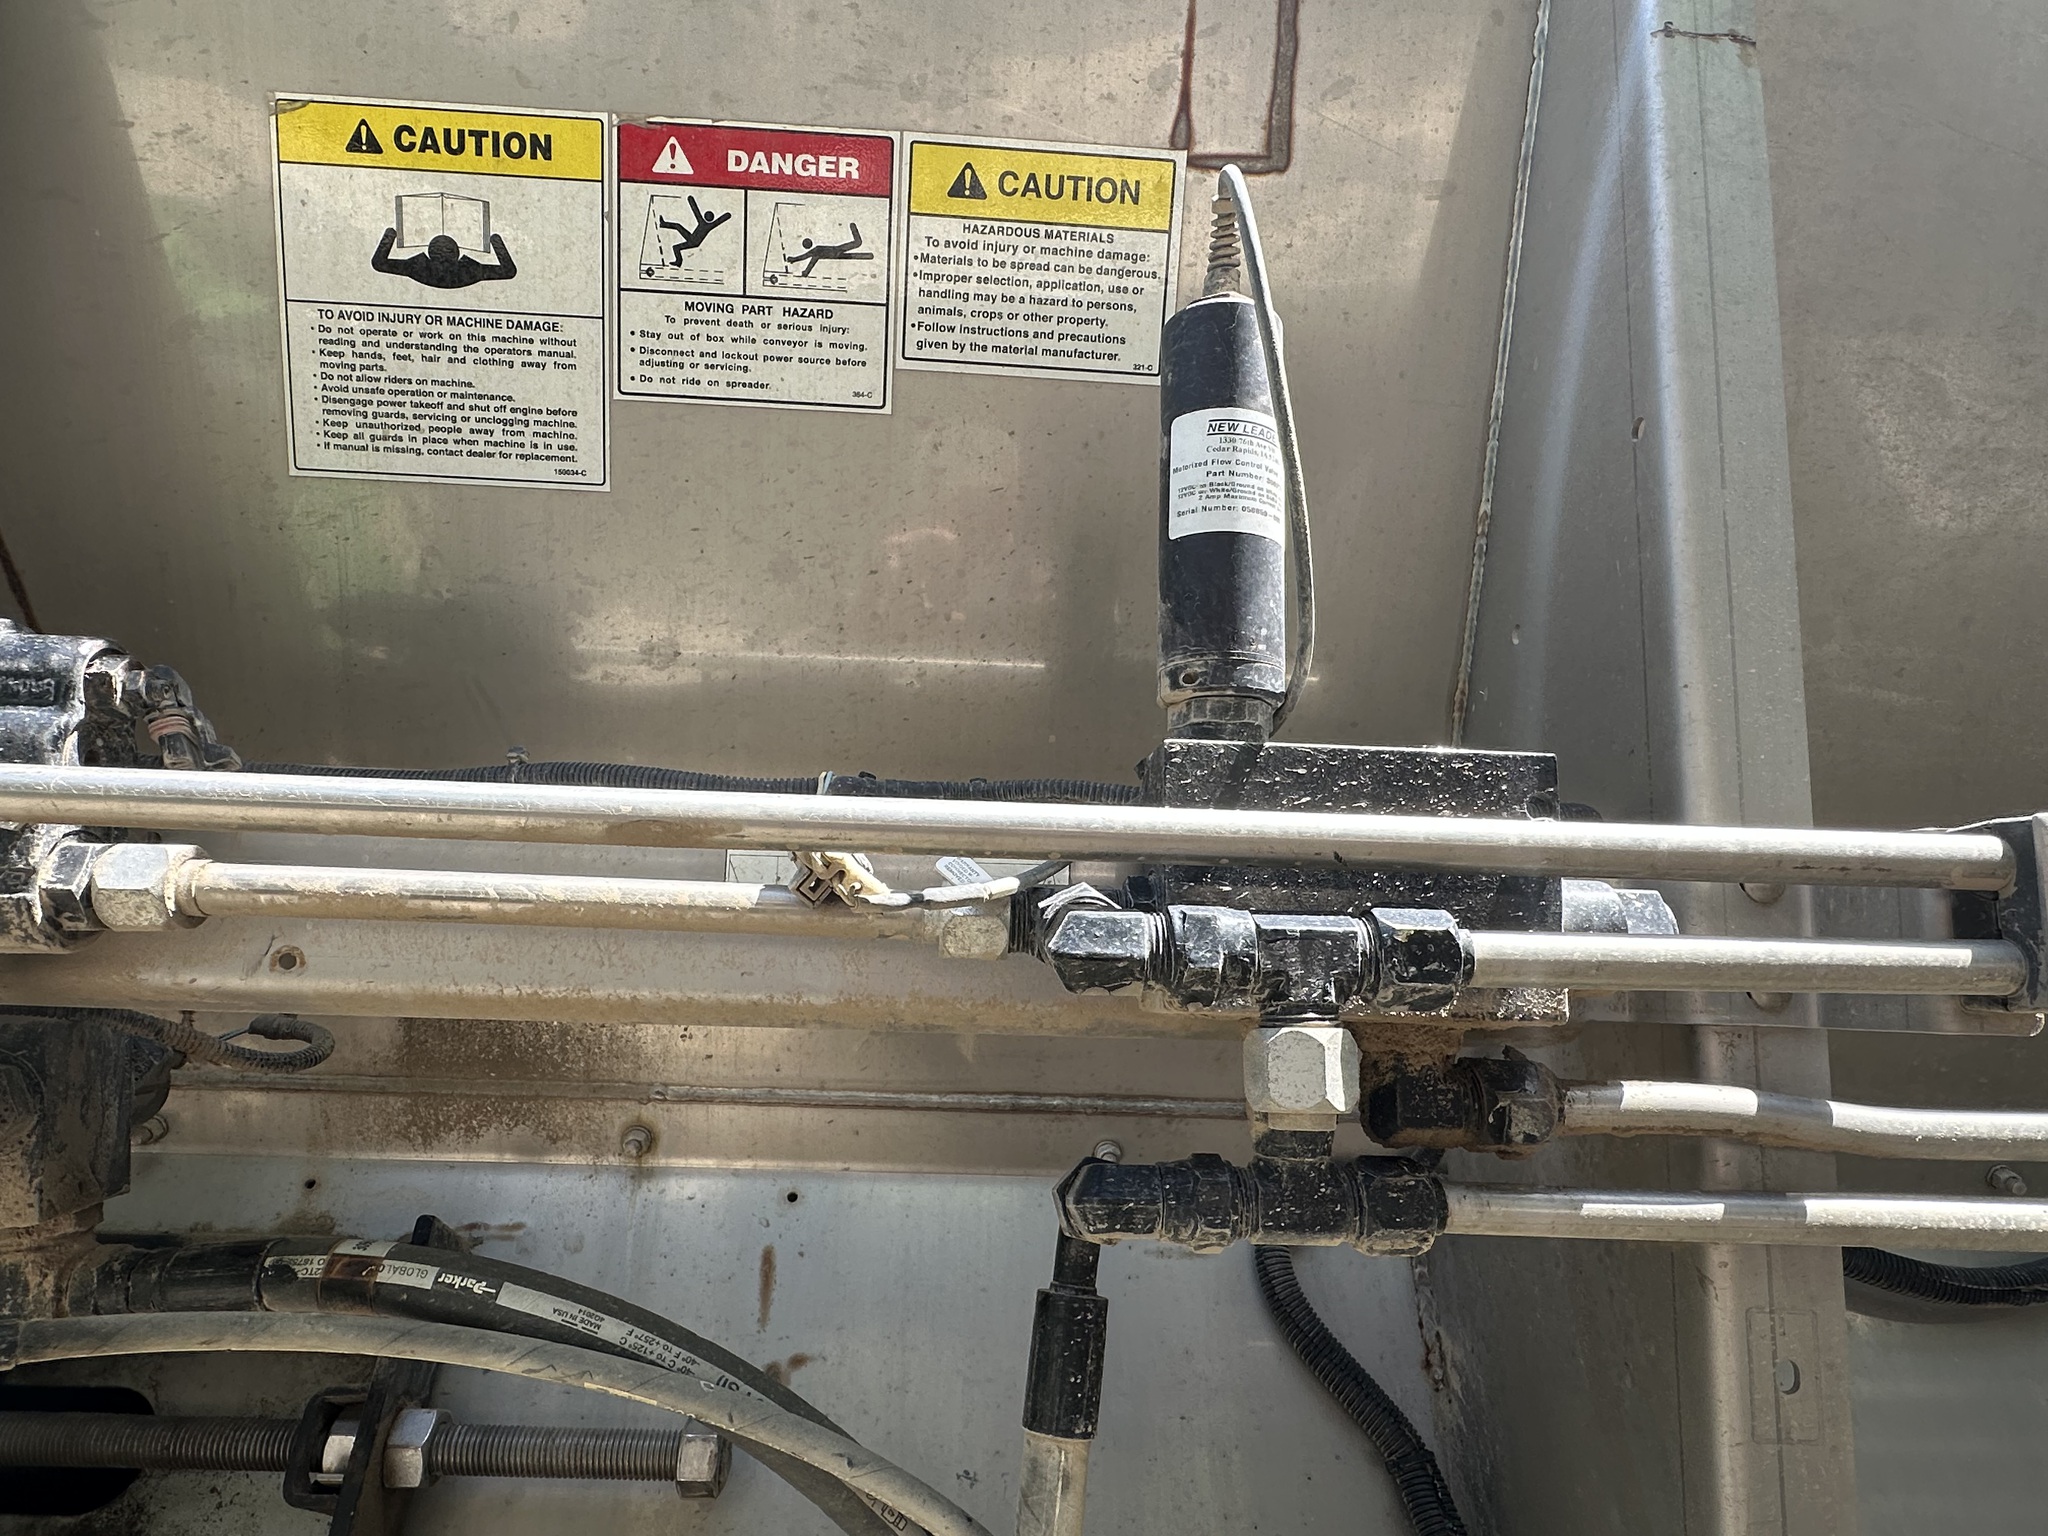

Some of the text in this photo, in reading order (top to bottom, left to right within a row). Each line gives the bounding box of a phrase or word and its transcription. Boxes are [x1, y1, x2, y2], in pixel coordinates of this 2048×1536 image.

[393, 125, 552, 161] CAUTION
[727, 150, 861, 180] DANGER
[998, 171, 1141, 205] CAUTION
[963, 223, 1114, 244] HAZARDOUS MATERIALS
[924, 236, 1150, 265] To avoid injury or machine damage:
[920, 252, 1161, 283] Materials to be spread can be dangerous.
[919, 269, 1145, 295] Improper selection, application, use or
[684, 301, 834, 319] MOVING PART HAZARD
[918, 287, 1137, 314] handling may be a hazard to persons,
[317, 308, 563, 332] TO AVOID INJURY OR MACHINE DAMAGE:
[664, 315, 676, 324] To
[683, 318, 721, 327] prevent
[726, 318, 754, 328] death
[777, 322, 813, 332] serious
[820, 324, 850, 335] injury:
[917, 305, 1108, 329] animals, crops or other property.
[318, 324, 577, 347] Do not operate or work on this machine without
[639, 329, 868, 353] Stay out of box while conveyor is moving.
[917, 321, 1126, 345] Follow instructions and precautions
[318, 337, 577, 359] reading and understanding the operators manual.
[639, 346, 867, 367] Disconnect and lockout power source before
[916, 338, 1121, 361] given by the material manufacturer.
[319, 348, 577, 371] Keep hands, feet, hair and clothing away from
[320, 360, 387, 373] moving parts.
[639, 358, 685, 370] adjusting
[704, 362, 751, 374] servicing.
[320, 371, 476, 388] Do not allow riders on machine.
[639, 374, 653, 383] Do
[659, 376, 676, 385] not
[681, 376, 701, 386] ride
[726, 380, 771, 390] spreader.
[321, 383, 349, 393] Avoid
[351, 386, 386, 395] unsafe
[387, 388, 435, 398] operation
[450, 390, 516, 402] maintenance.
[1207, 422, 1239, 433] NEW
[1206, 445, 1231, 453] Cedar
[1219, 436, 1236, 444] 1330
[1238, 437, 1254, 447] 76th
[1172, 459, 1208, 475] Motorized
[1235, 459, 1263, 470] Control
[1206, 470, 1225, 478] Part
[1177, 505, 1239, 518] Serial Number:
[437, 1273, 496, 1294] Parker
[553, 1307, 601, 1330] MADE IN USA
[619, 1336, 627, 1346] C
[626, 1328, 634, 1337] F
[667, 1360, 676, 1369] C
[673, 1351, 681, 1359] F
